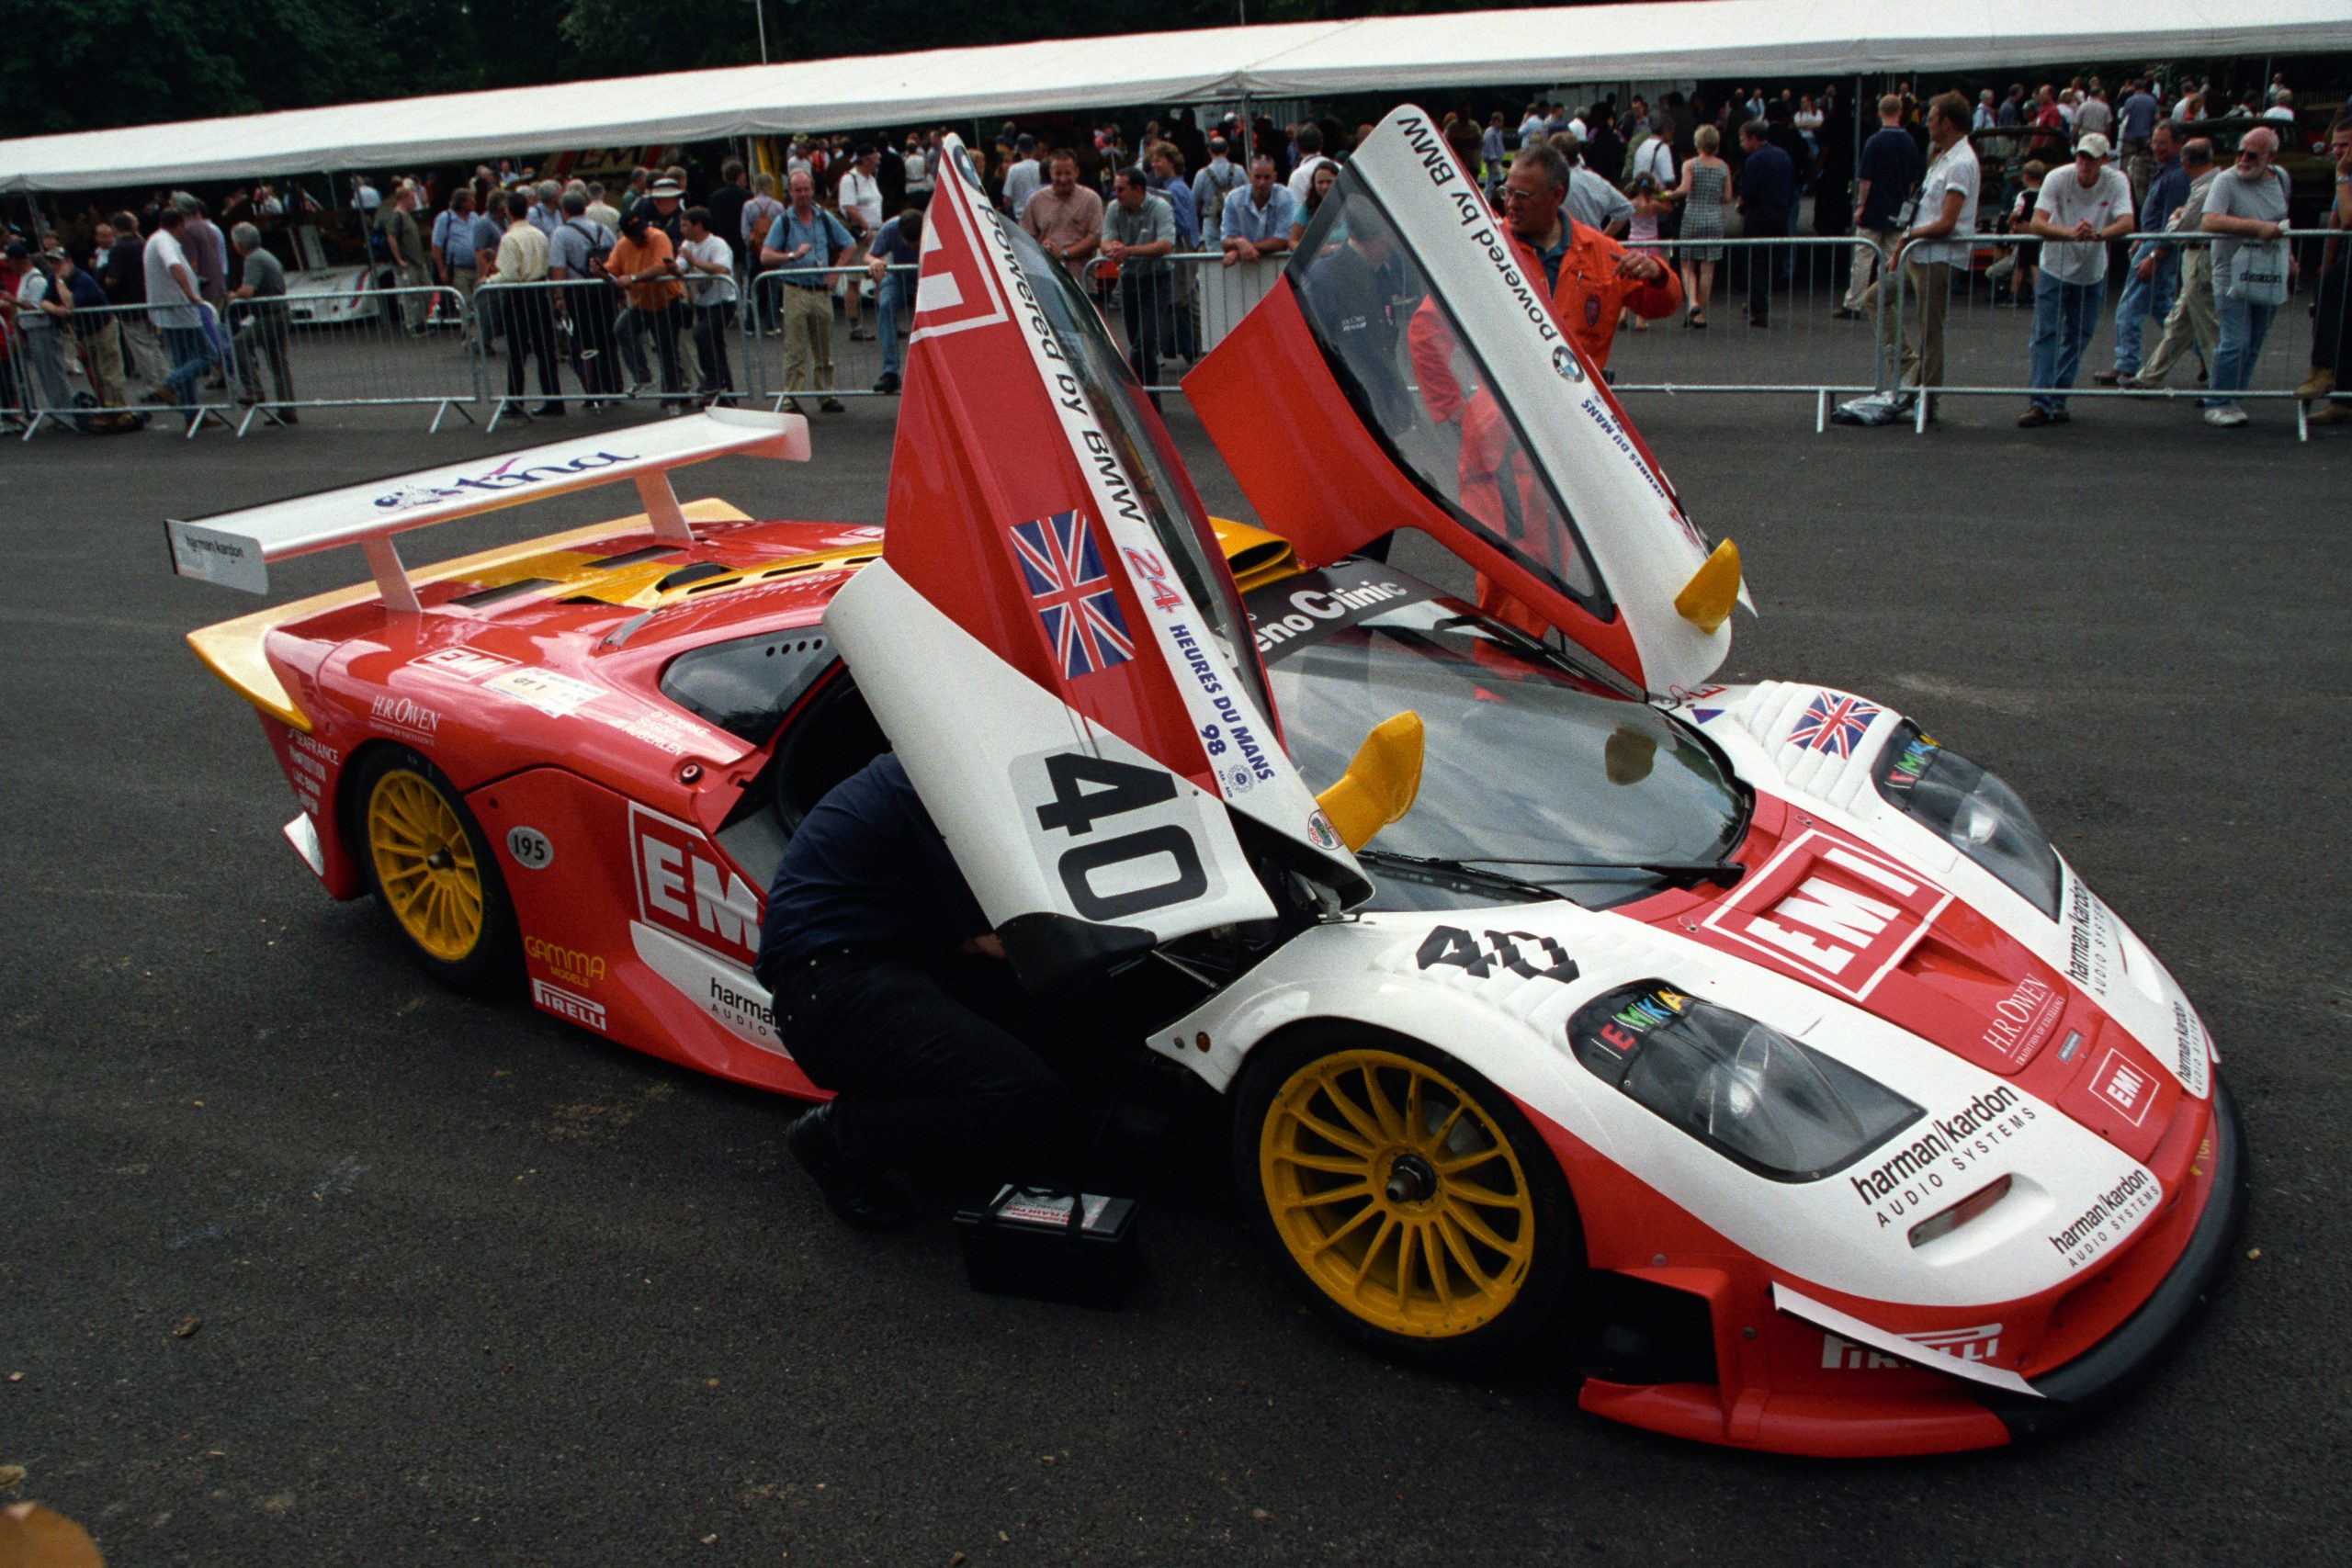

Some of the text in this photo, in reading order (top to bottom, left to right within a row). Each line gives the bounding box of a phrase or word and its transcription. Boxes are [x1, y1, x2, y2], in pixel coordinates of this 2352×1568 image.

[1396, 116, 1559, 342] powered by BMW
[978, 204, 1146, 523] powered by BMW
[1581, 398, 1615, 435] MANS
[423, 648, 505, 674] EMI
[1121, 545, 1275, 782] 24 HEURES DU MANS
[1200, 722, 1227, 758] 98
[1889, 734, 1940, 783] EMK
[514, 834, 546, 862] 195
[1036, 752, 1209, 922] 40
[642, 832, 763, 954] EM
[1744, 847, 1920, 976] EMI
[525, 935, 605, 980] GAMMA
[550, 965, 590, 988] MODELS
[1416, 924, 1581, 985] 40
[2094, 953, 2108, 997] AUDIO
[532, 977, 607, 1032] PIRELLI
[711, 1003, 768, 1037] AUDIO
[2016, 995, 2066, 1066] TRADITION OF EXCELLENCE
[2106, 1065, 2144, 1110] EMI
[1849, 1084, 2019, 1207] harman/kardon
[1875, 1106, 2037, 1229] AUDIO SYSTEMS
[2048, 1167, 2149, 1256] harman/kardon
[2067, 1184, 2160, 1269] AUDIO SYSTEMS
[1821, 1322, 2004, 1369] PIRLI
